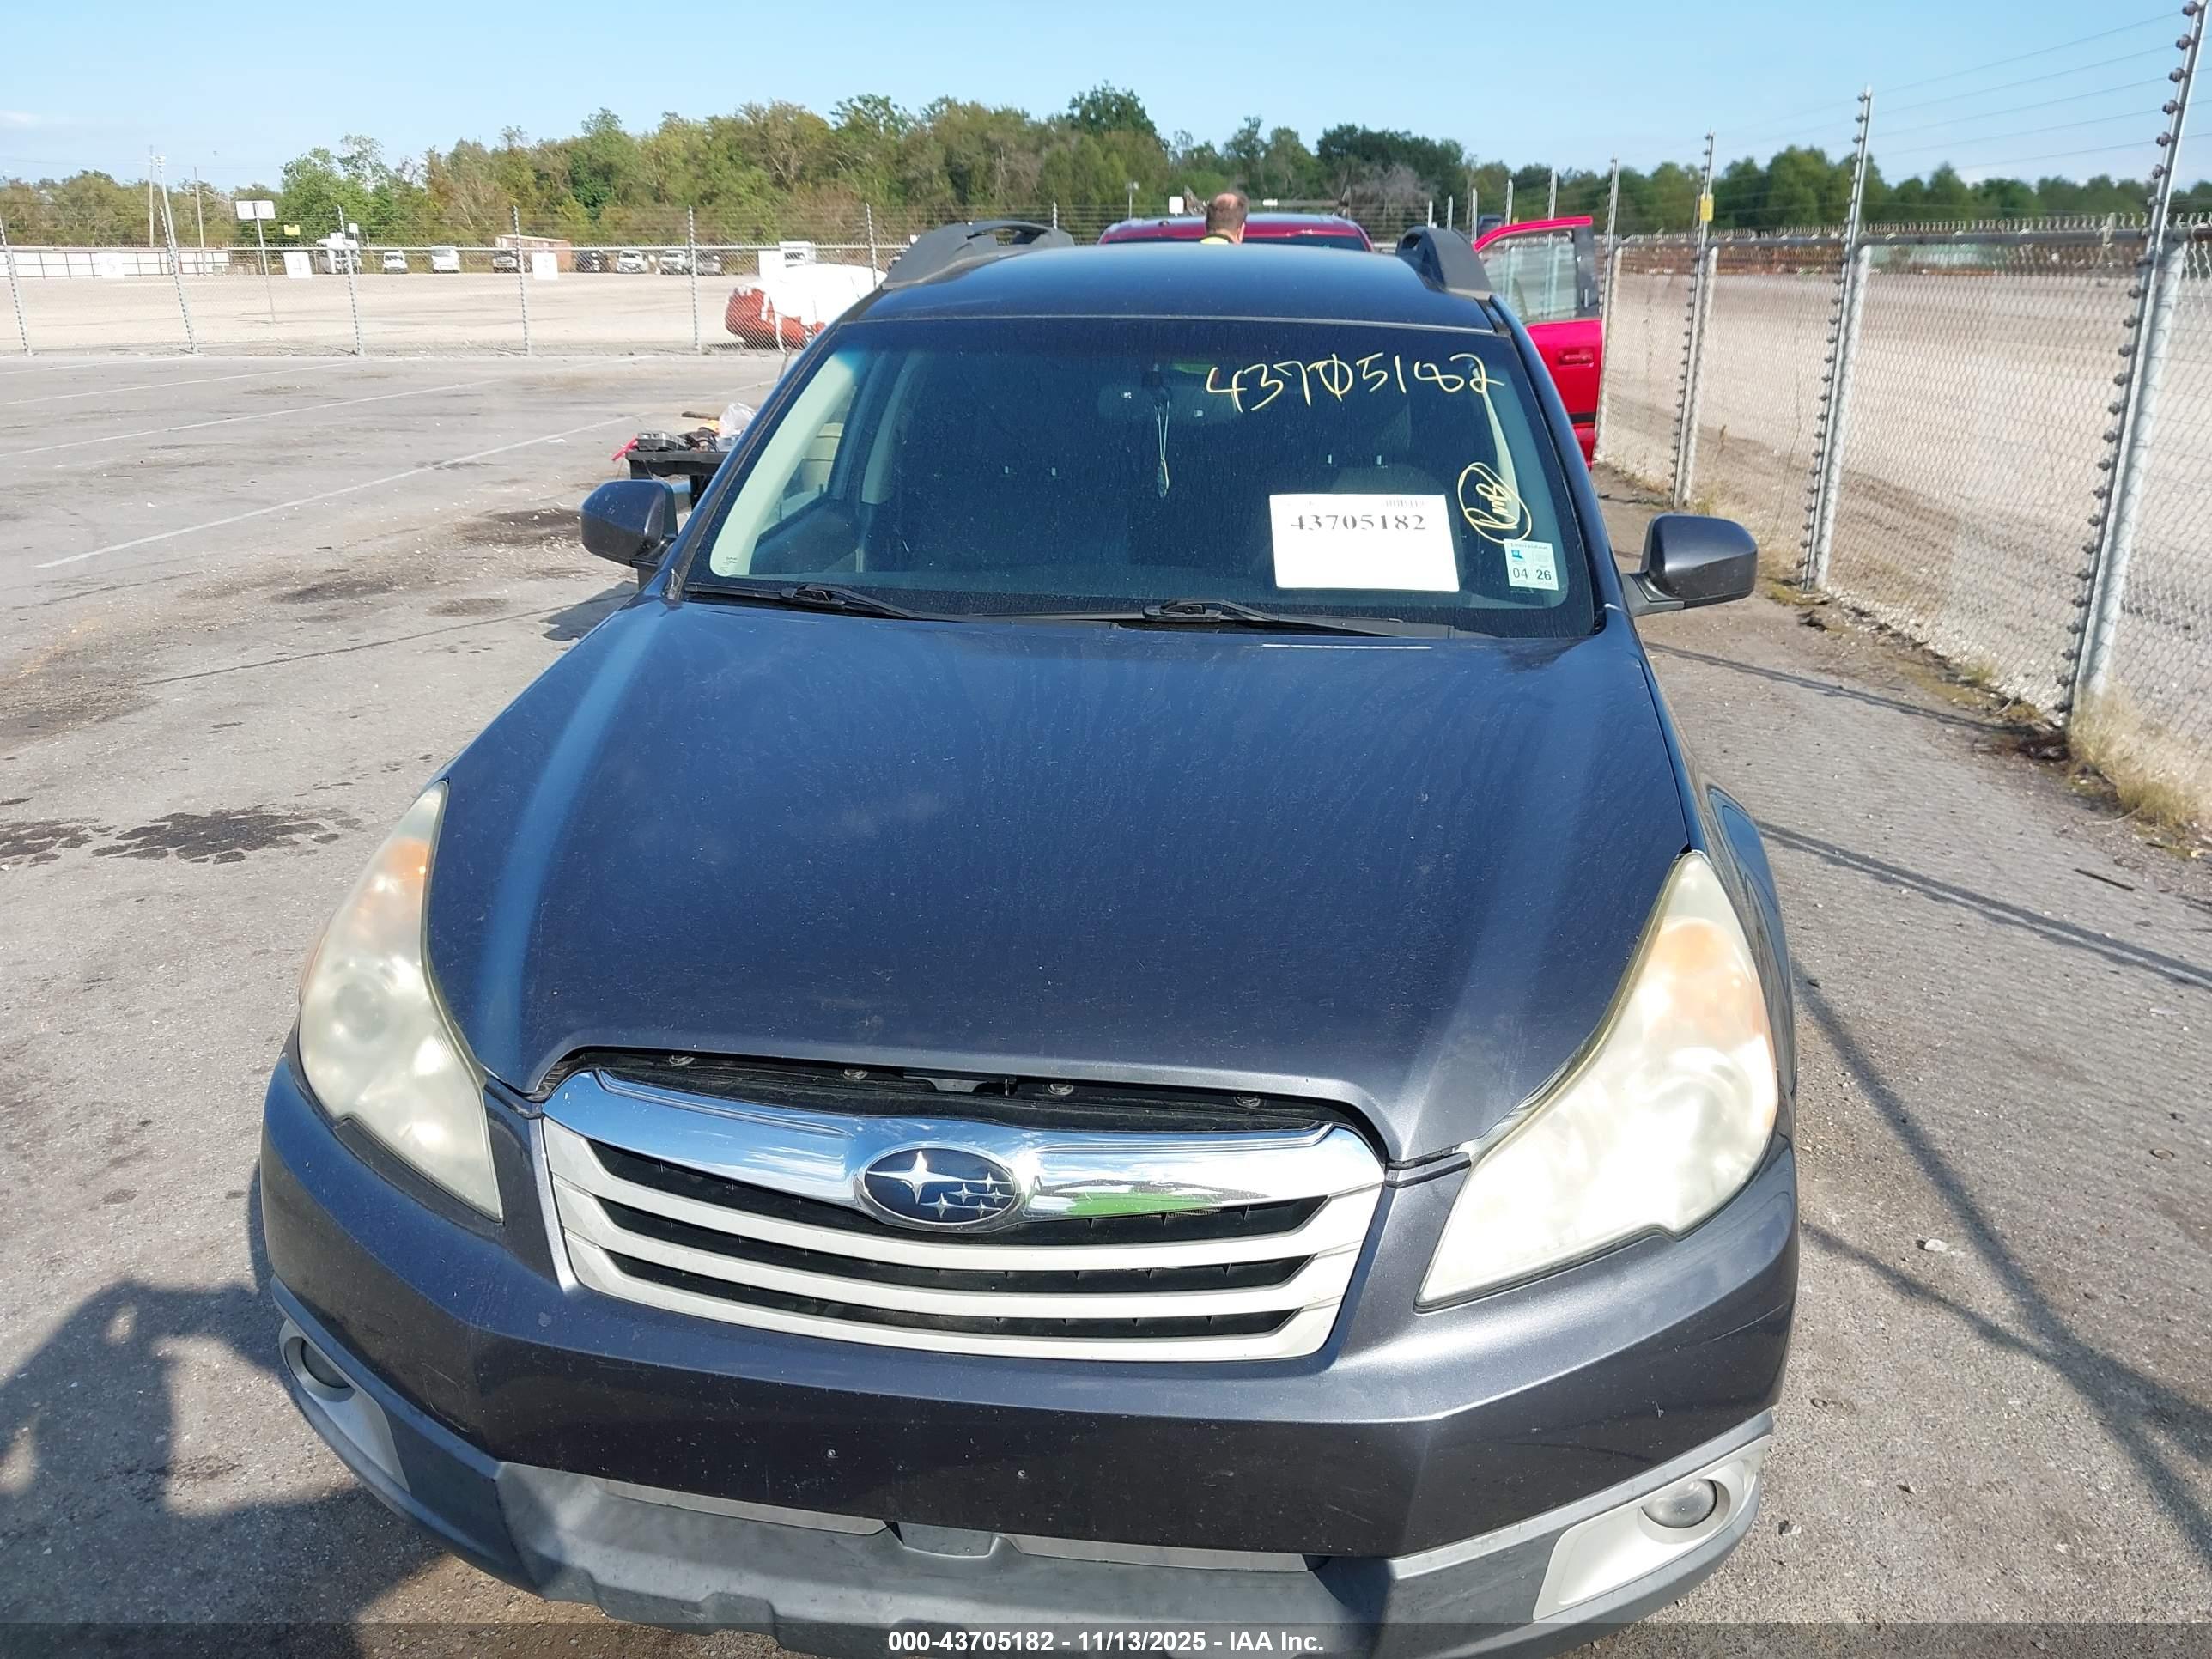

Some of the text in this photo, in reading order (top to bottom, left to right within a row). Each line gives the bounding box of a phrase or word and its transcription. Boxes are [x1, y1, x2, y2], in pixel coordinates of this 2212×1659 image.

[1206, 352, 1505, 413] 43705182
[1291, 514, 1426, 531] 43705182
[1513, 567, 1552, 581] 04 26
